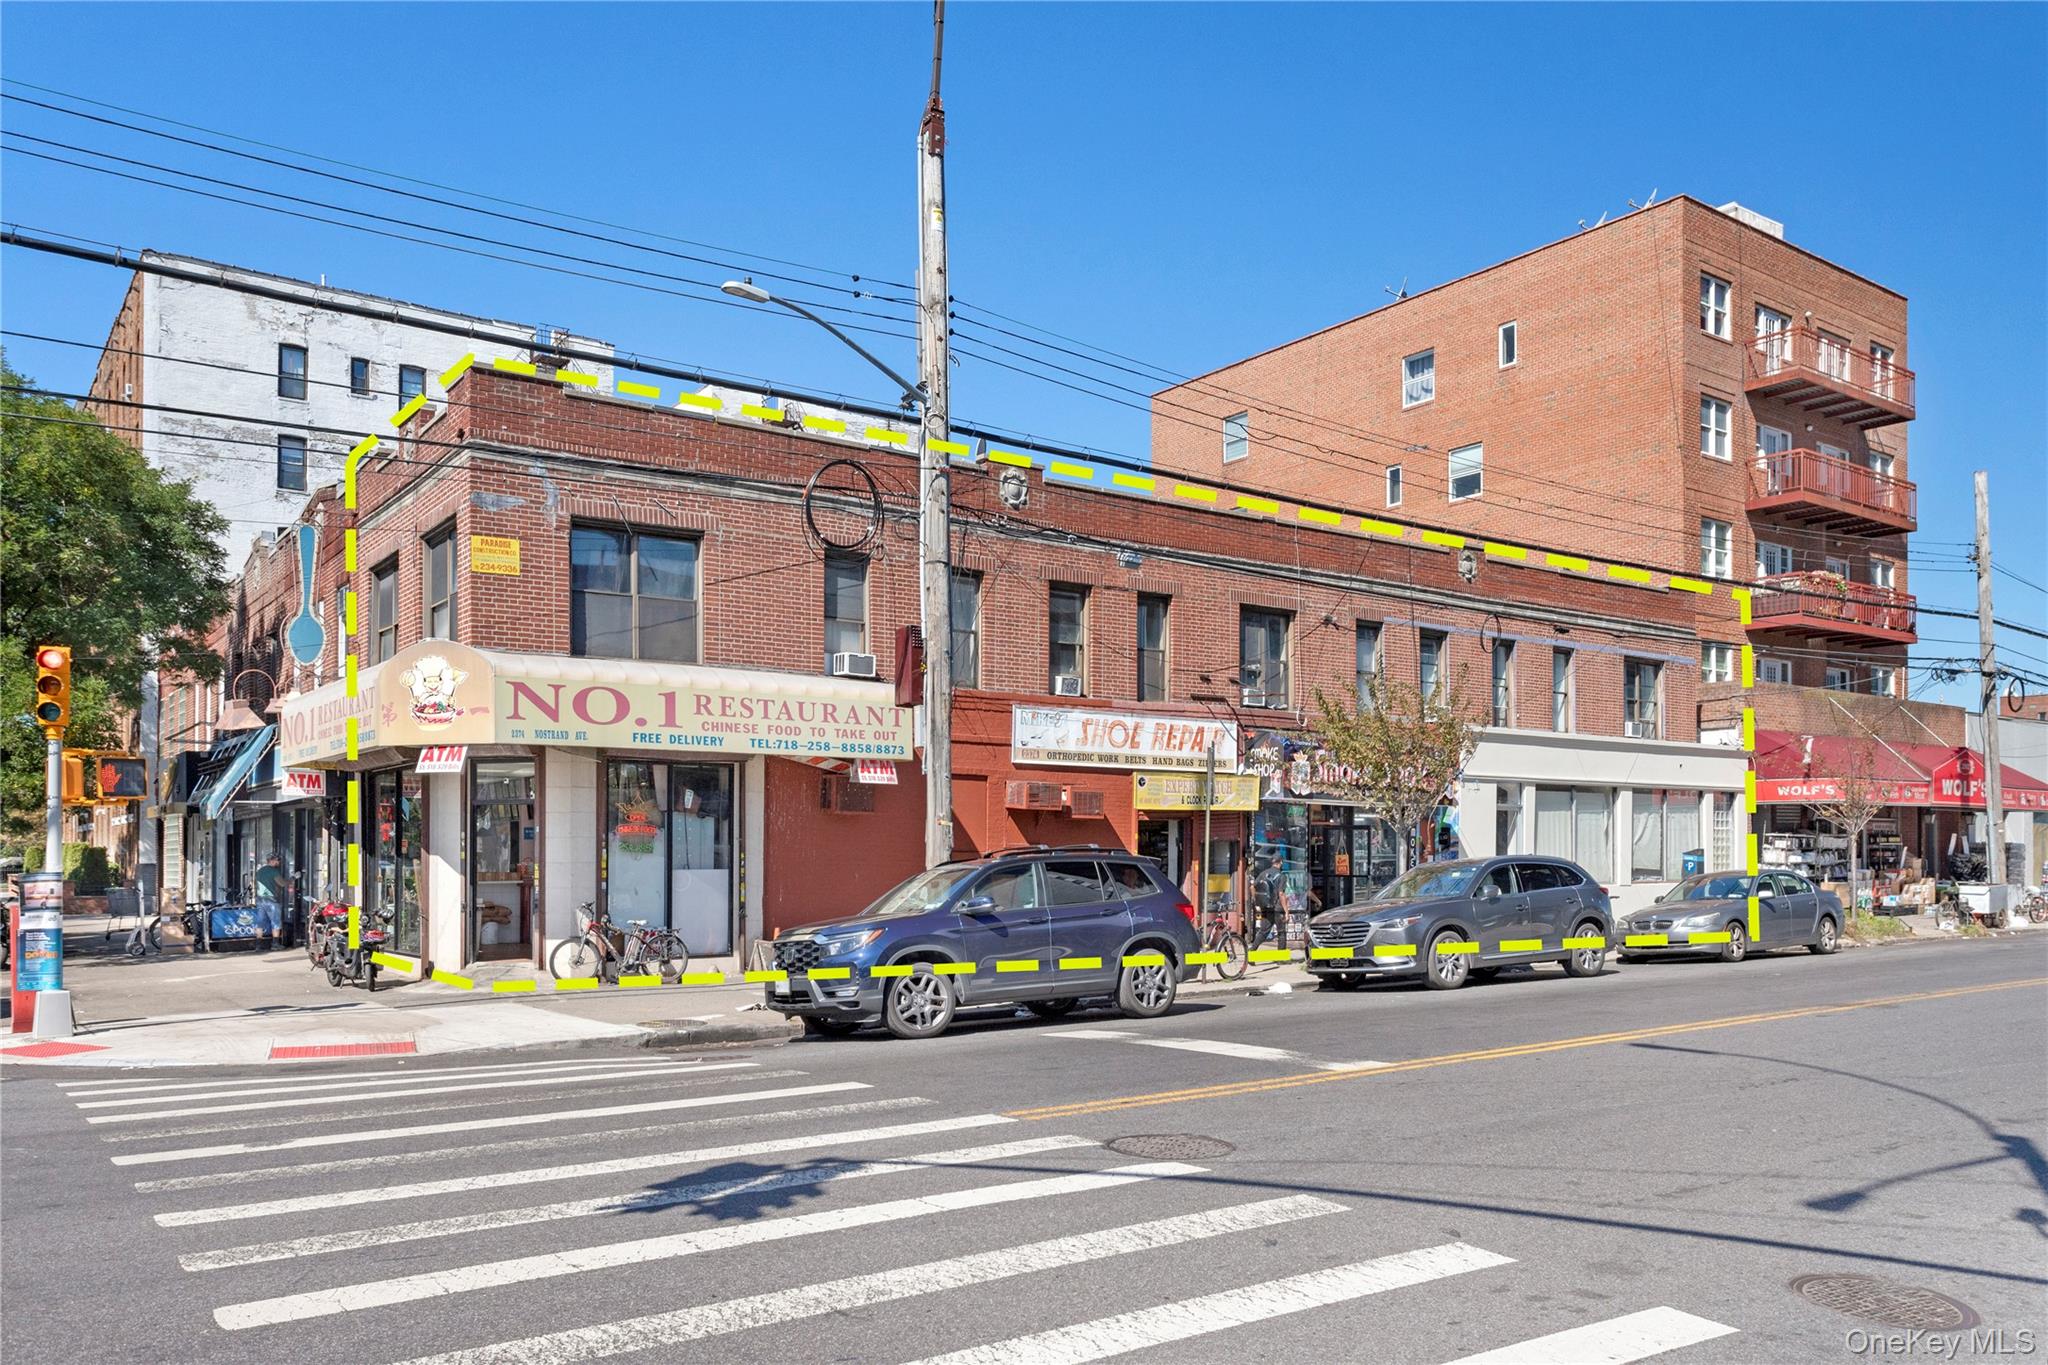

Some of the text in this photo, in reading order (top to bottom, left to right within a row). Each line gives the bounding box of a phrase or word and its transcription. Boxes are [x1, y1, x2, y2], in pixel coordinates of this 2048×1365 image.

[505, 680, 905, 728] NO.1 RESTAURANT
[283, 707, 315, 750] NO.1
[511, 729, 589, 741] 2374 NOSTRAND AVE.
[701, 721, 897, 741] CHINESE FOOD TO TAKE OUT
[1077, 718, 1145, 749] SHOE
[632, 732, 724, 747] FREE DELIVERY
[421, 745, 464, 762] ATM
[1047, 751, 1094, 763] ORTHOPEDIC
[1097, 754, 1119, 764] WORK
[1125, 755, 1146, 765] BELTS
[1152, 756, 1173, 766] HAND
[1176, 758, 1194, 767] BAGS
[1198, 759, 1227, 768] ZIERS
[860, 759, 894, 775] ATM
[1254, 763, 1275, 777] SHOP
[287, 772, 321, 789] ATM
[1777, 784, 1836, 796] WOLF'S
